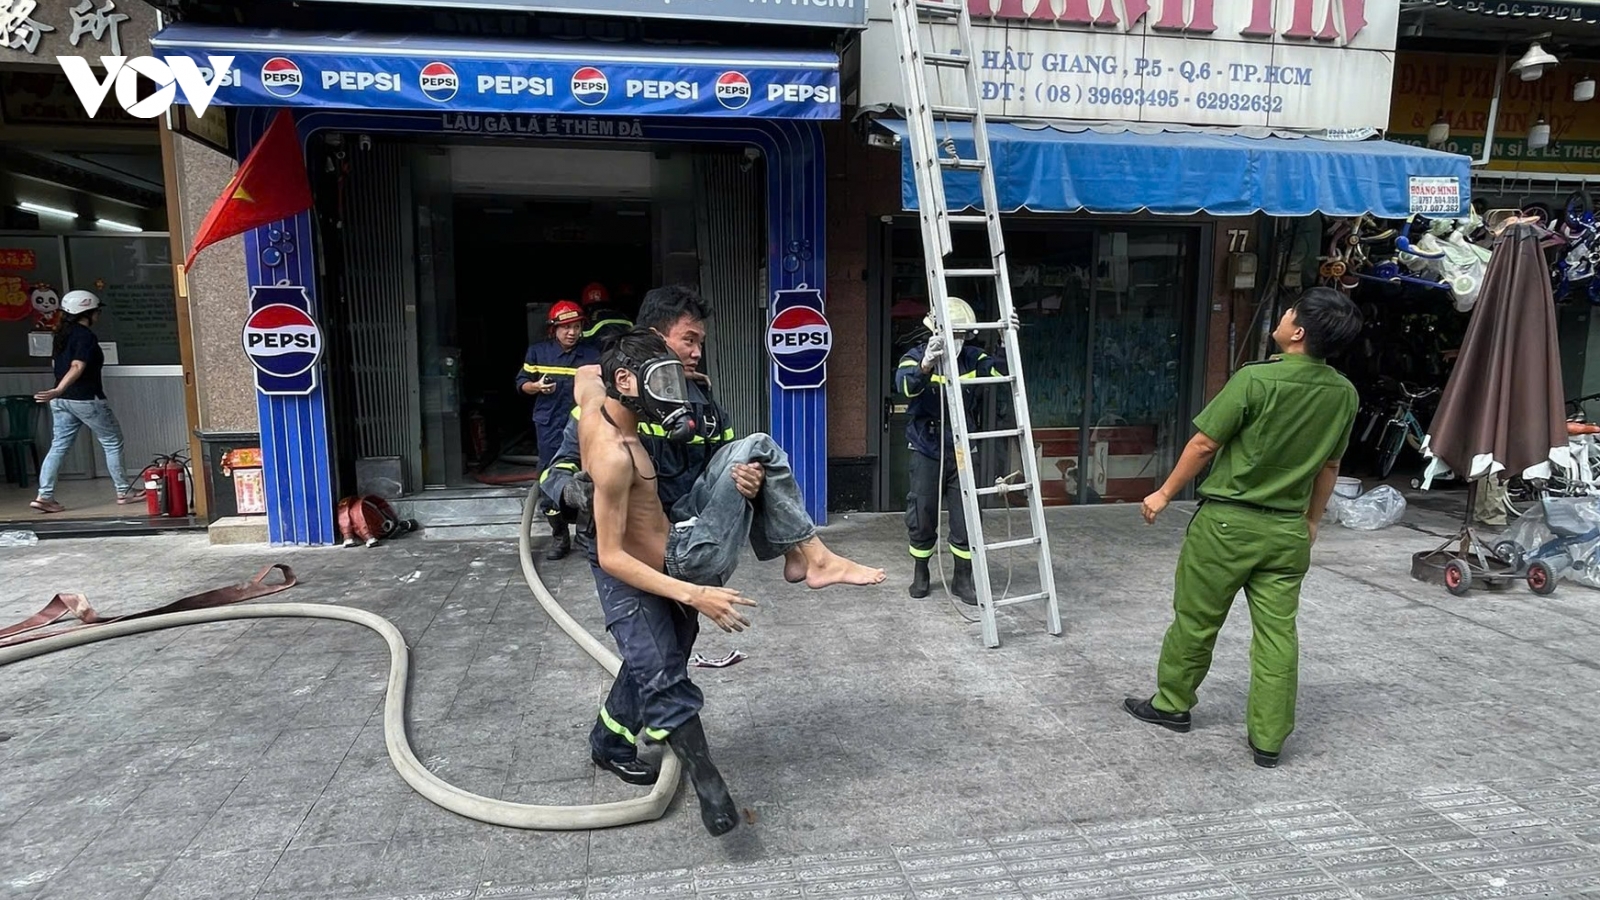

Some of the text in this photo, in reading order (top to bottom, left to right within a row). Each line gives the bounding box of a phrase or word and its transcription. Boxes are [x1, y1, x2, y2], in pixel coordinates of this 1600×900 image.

[982, 45, 1033, 74] HẬU
[1134, 58, 1162, 77] P.5
[1179, 60, 1211, 83] Q.6
[1228, 64, 1312, 86] TP.HCM
[264, 73, 300, 83] PEPSI
[321, 70, 401, 92] PEPSI
[422, 76, 456, 87] PEPSI
[477, 75, 553, 96] PEPSI
[573, 81, 607, 91] PEPSI
[626, 79, 698, 99] PEPSI
[718, 85, 749, 95] PEPSI
[767, 84, 836, 103] PEPSI
[1088, 87, 1179, 107] 39693495
[1196, 91, 1283, 112] 62932632
[1471, 143, 1504, 156] BN
[1227, 229, 1249, 252] 77
[248, 333, 317, 348] PEPSI
[771, 331, 829, 347] PEPSI
